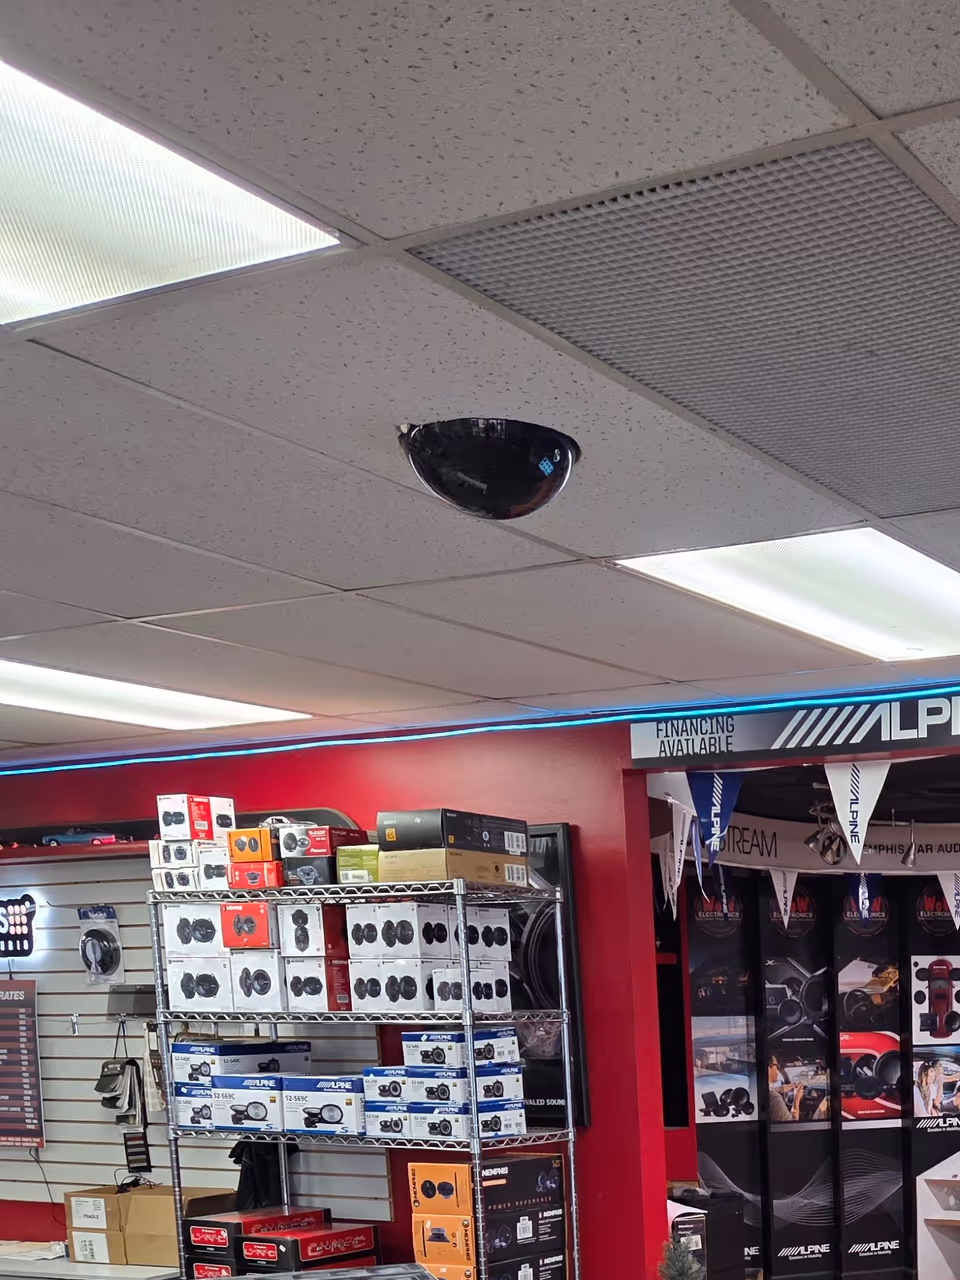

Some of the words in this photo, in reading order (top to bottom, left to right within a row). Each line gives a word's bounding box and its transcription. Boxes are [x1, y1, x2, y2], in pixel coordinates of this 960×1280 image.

[656, 716, 735, 739] FINANCING
[658, 735, 733, 757] AVAILABLE
[850, 790, 861, 845] ALPINE
[863, 843, 905, 854] EMPHIS
[251, 1079, 276, 1087] ALPINE
[327, 1081, 352, 1089] ALPINE
[482, 1167, 509, 1177] MEMPHIS
[795, 1244, 830, 1255] ALPINE
[865, 1240, 900, 1251] ALPINE
